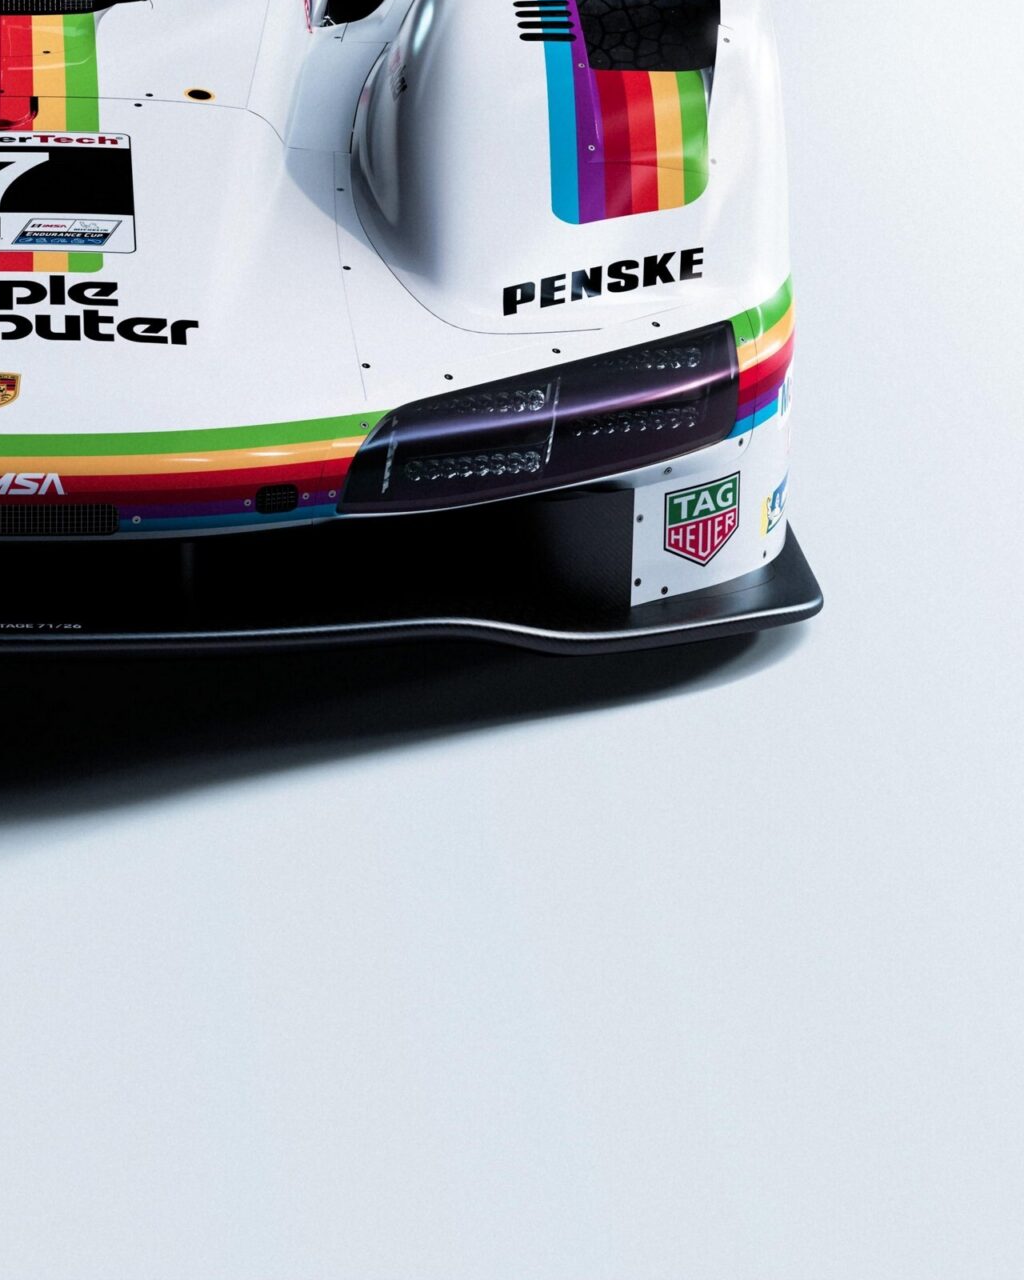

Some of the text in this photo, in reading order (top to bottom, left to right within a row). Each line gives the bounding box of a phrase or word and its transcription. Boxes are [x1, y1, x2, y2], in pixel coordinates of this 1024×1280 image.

[502, 247, 704, 317] PENSKE
[673, 482, 733, 520] TAG
[670, 511, 735, 557] HEUER
